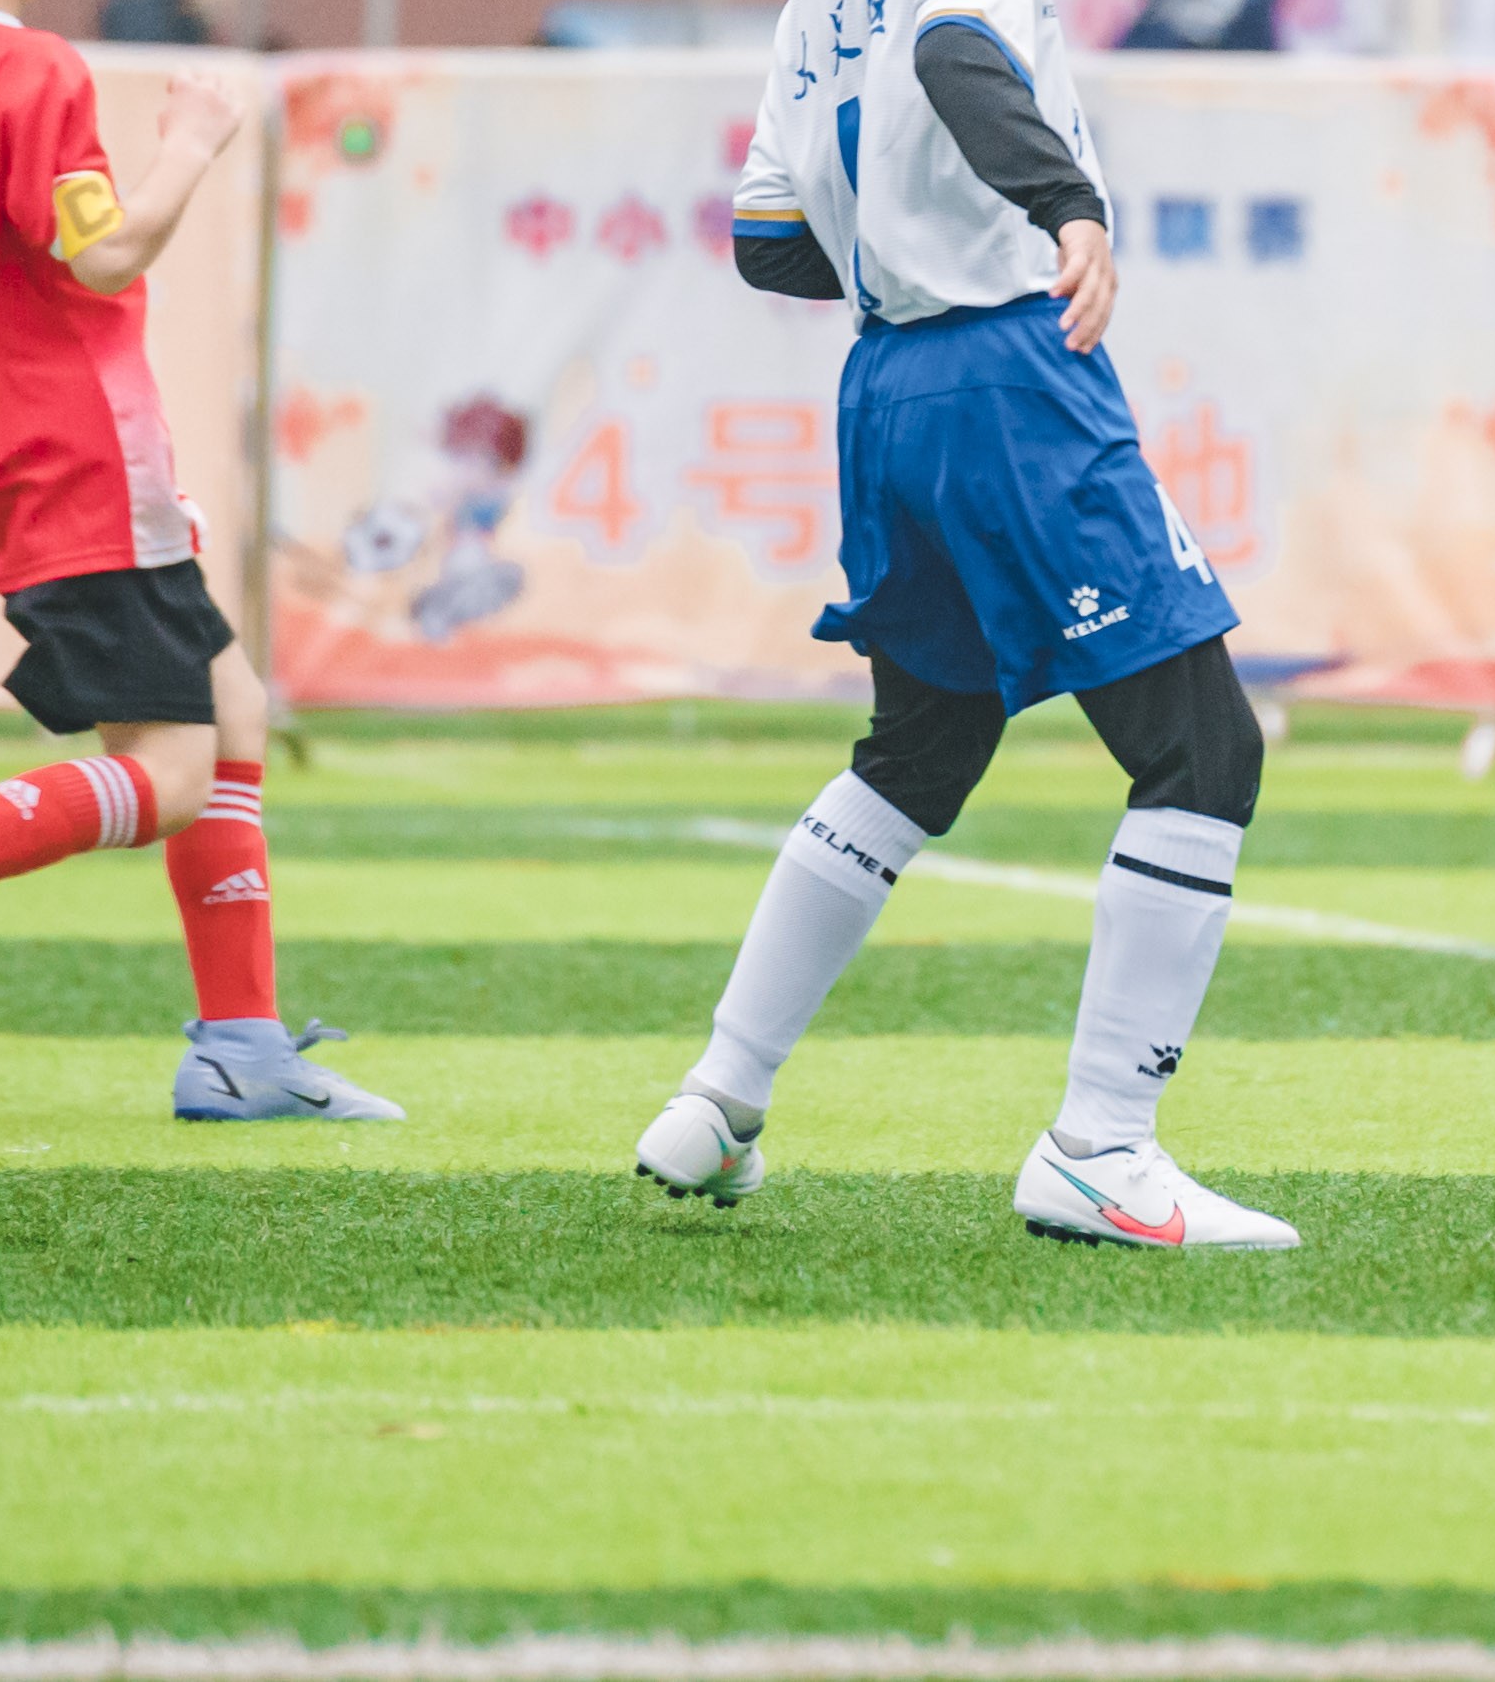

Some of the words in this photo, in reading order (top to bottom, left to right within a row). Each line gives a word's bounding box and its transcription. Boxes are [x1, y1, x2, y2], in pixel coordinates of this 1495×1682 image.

[62, 179, 123, 238] C
[552, 403, 1257, 564] 4号地
[1154, 483, 1214, 585] 4
[1062, 605, 1131, 640] KELME
